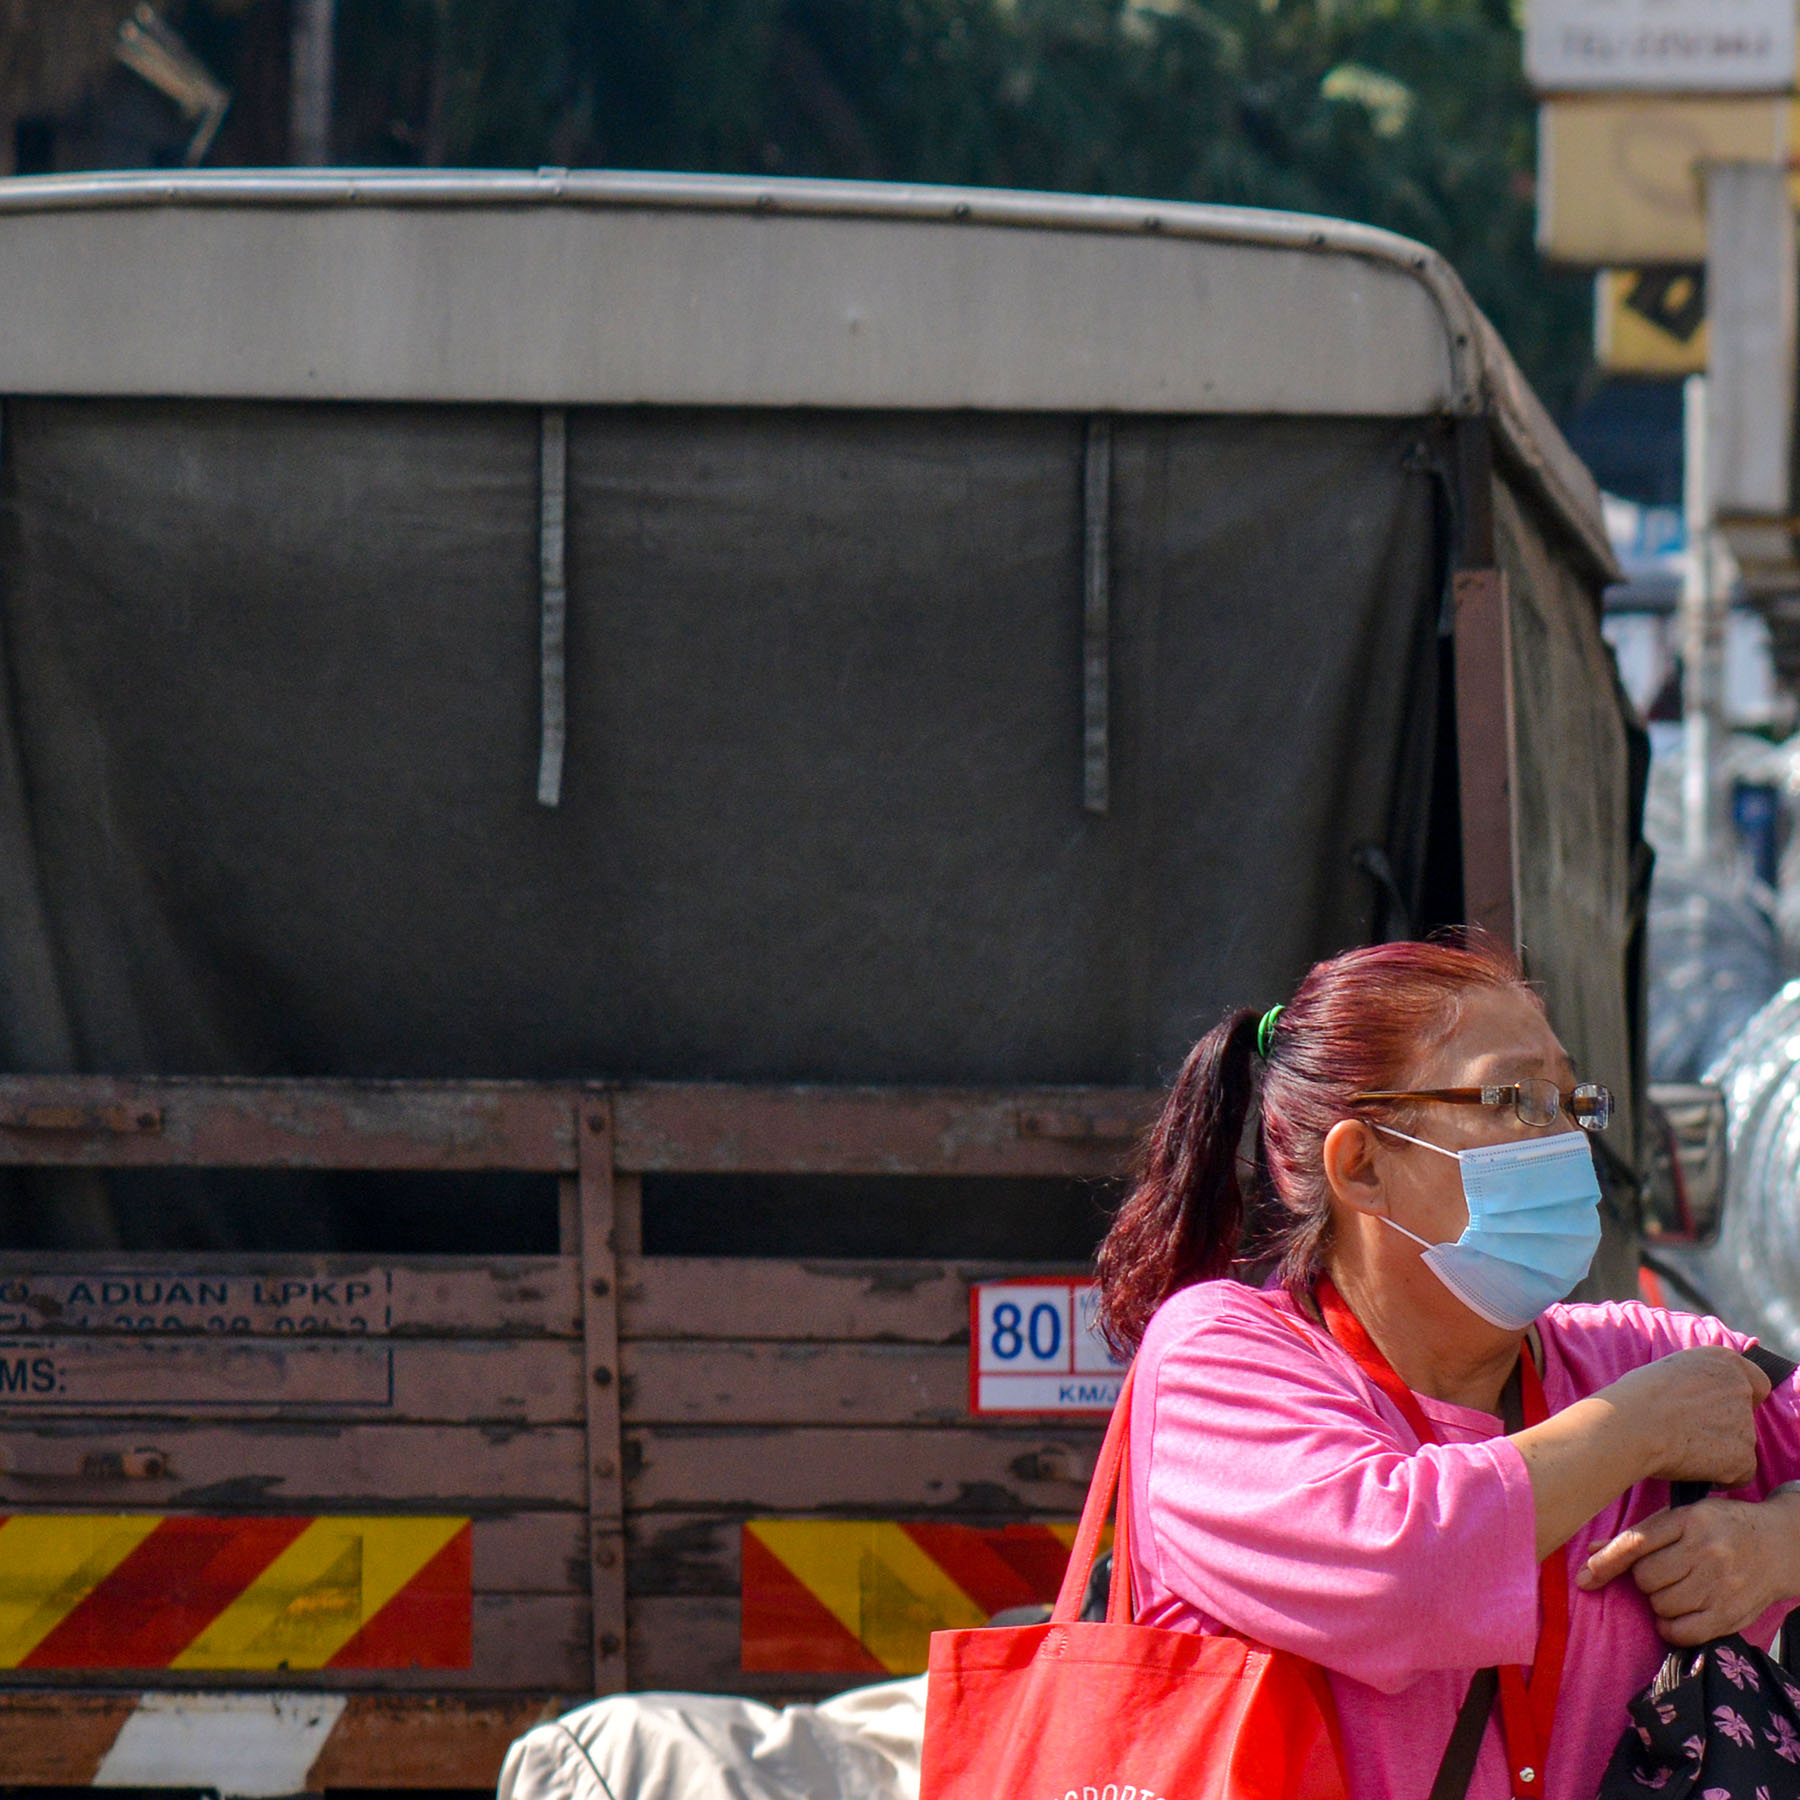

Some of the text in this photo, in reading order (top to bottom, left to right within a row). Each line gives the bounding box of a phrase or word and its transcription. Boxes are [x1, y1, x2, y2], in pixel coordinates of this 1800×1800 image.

[68, 1281, 228, 1306] ADUAN
[254, 1282, 372, 1307] LPKP
[991, 1301, 1062, 1361] 80
